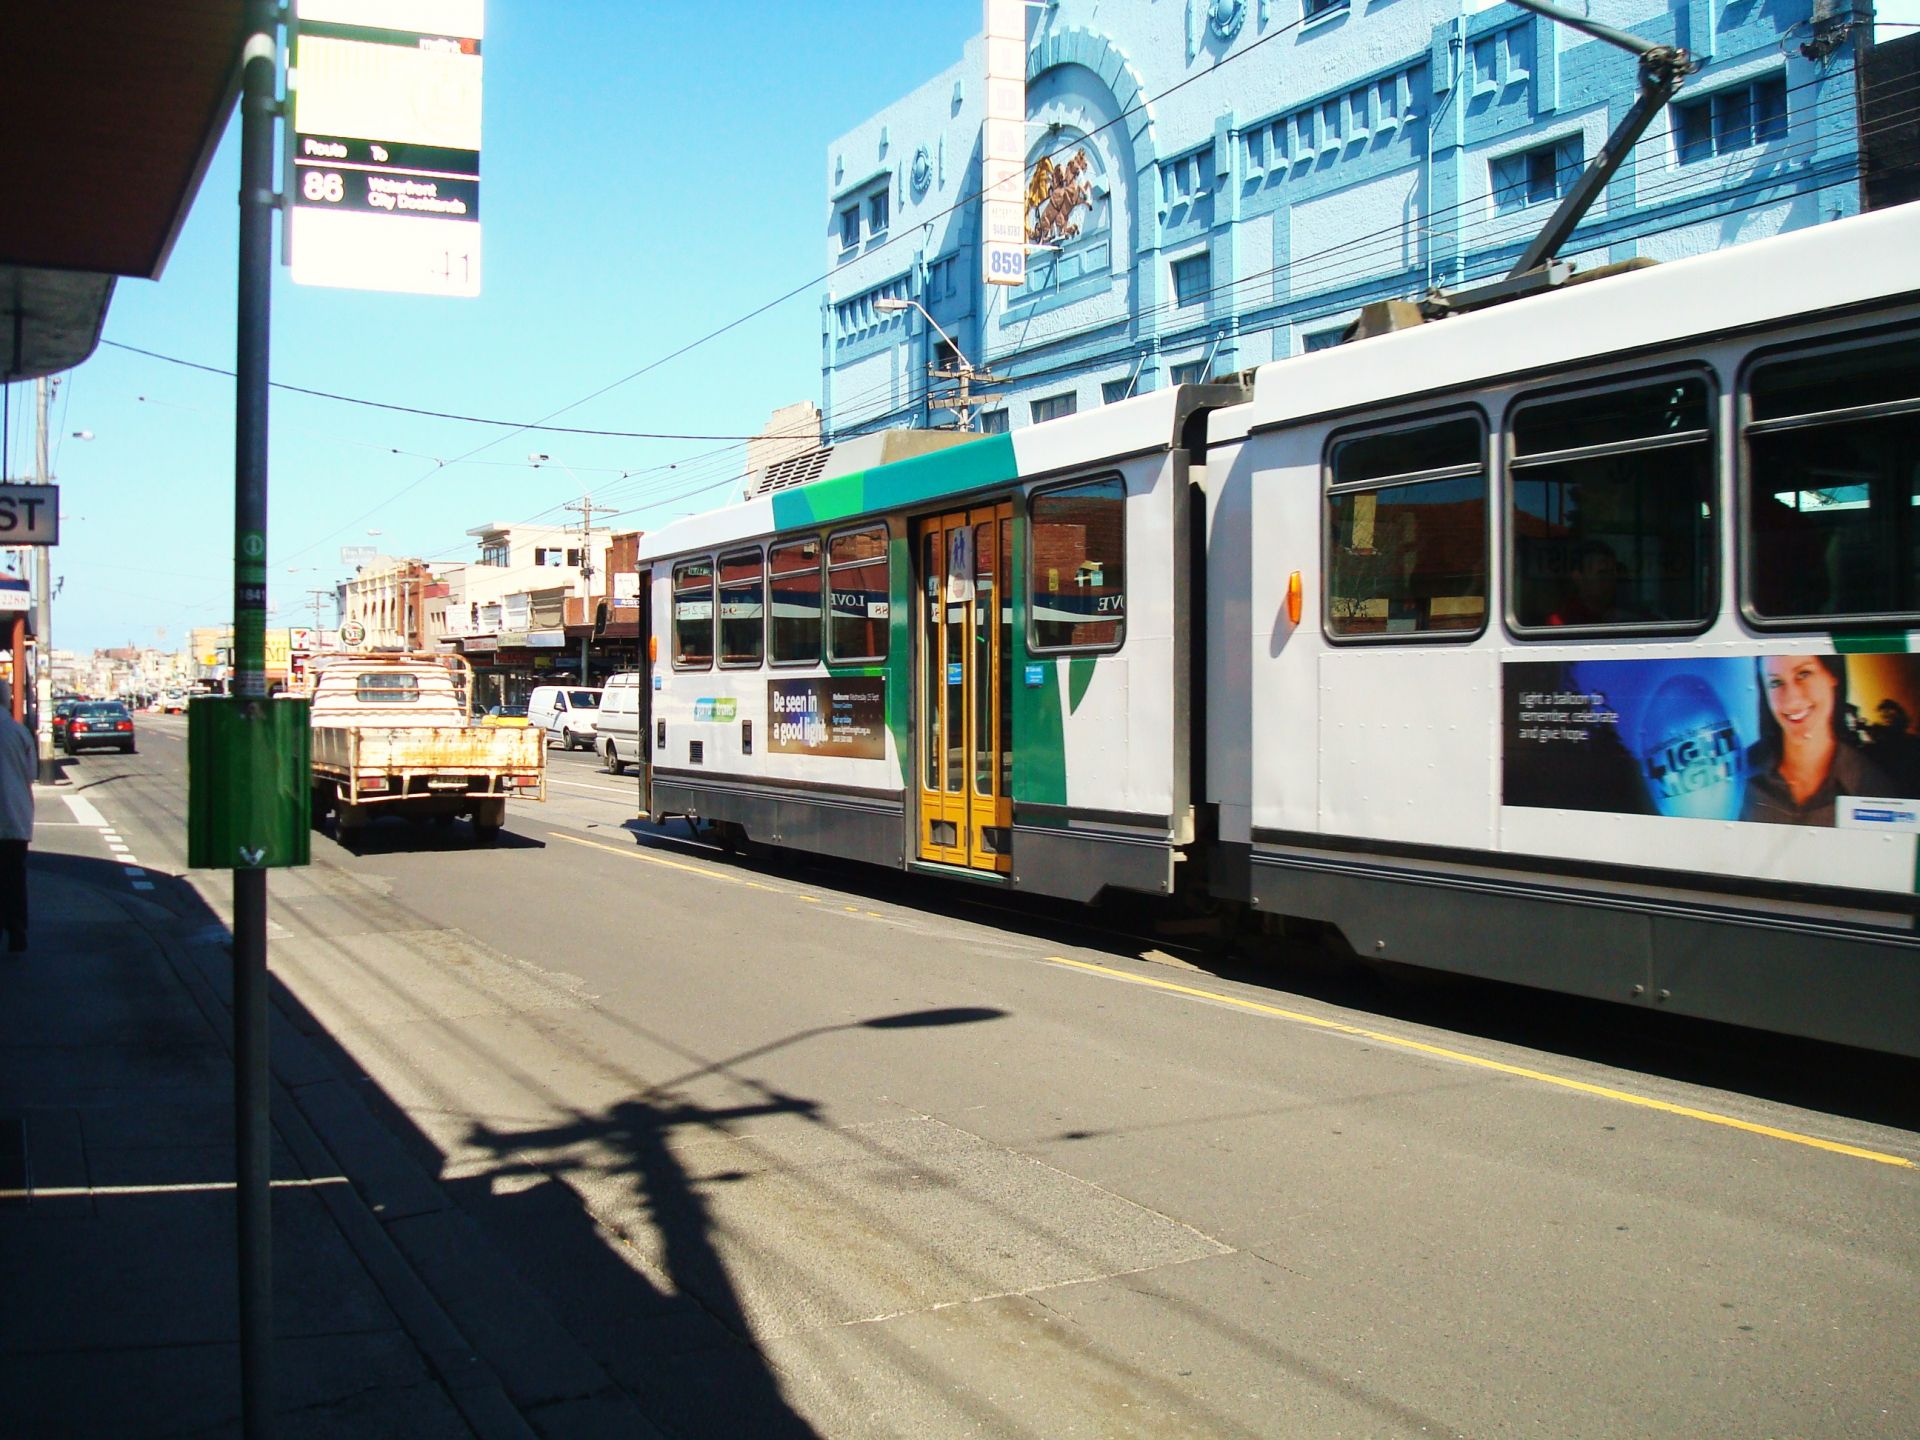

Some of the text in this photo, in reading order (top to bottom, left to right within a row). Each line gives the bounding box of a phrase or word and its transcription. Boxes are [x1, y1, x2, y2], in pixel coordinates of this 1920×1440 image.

[304, 139, 389, 162] Route To
[304, 172, 344, 202] 86
[367, 176, 437, 198] Waterfront
[367, 191, 467, 215] City Docklands
[991, 250, 1022, 275] 859
[773, 688, 818, 713] Be seen in
[1519, 692, 1542, 709] Light
[1553, 691, 1589, 705] balloon
[1590, 692, 1604, 705] to
[1571, 709, 1620, 723] celebrate
[773, 716, 829, 748] a good light.
[1519, 726, 1589, 743] and give hope
